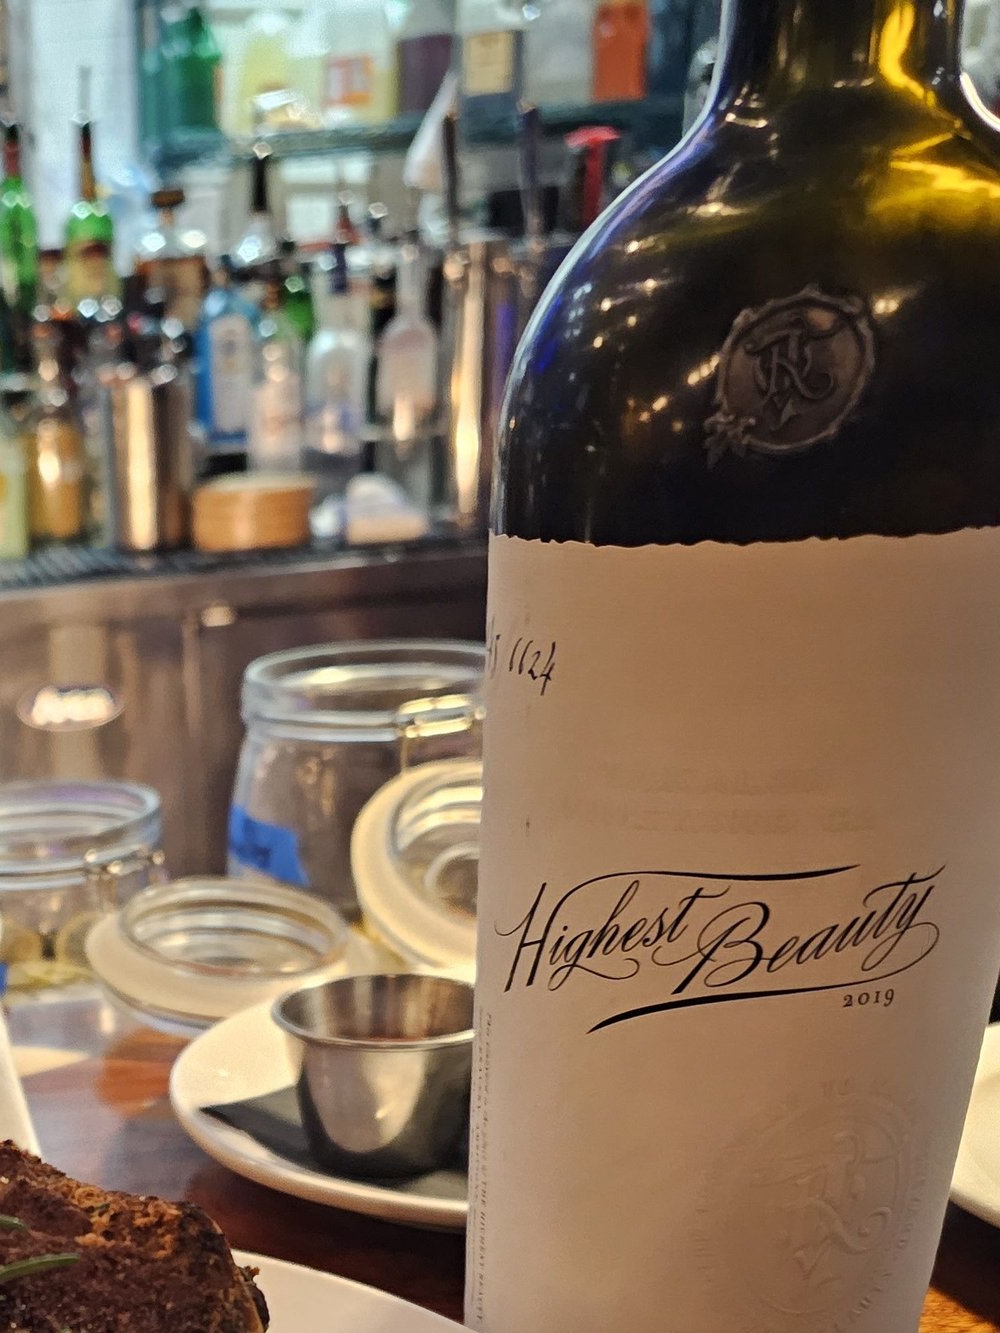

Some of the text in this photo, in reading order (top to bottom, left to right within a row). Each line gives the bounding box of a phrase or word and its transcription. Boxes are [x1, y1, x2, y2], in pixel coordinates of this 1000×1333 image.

[495, 864, 946, 995] Highest Beauty
[843, 988, 895, 1007] 2019
